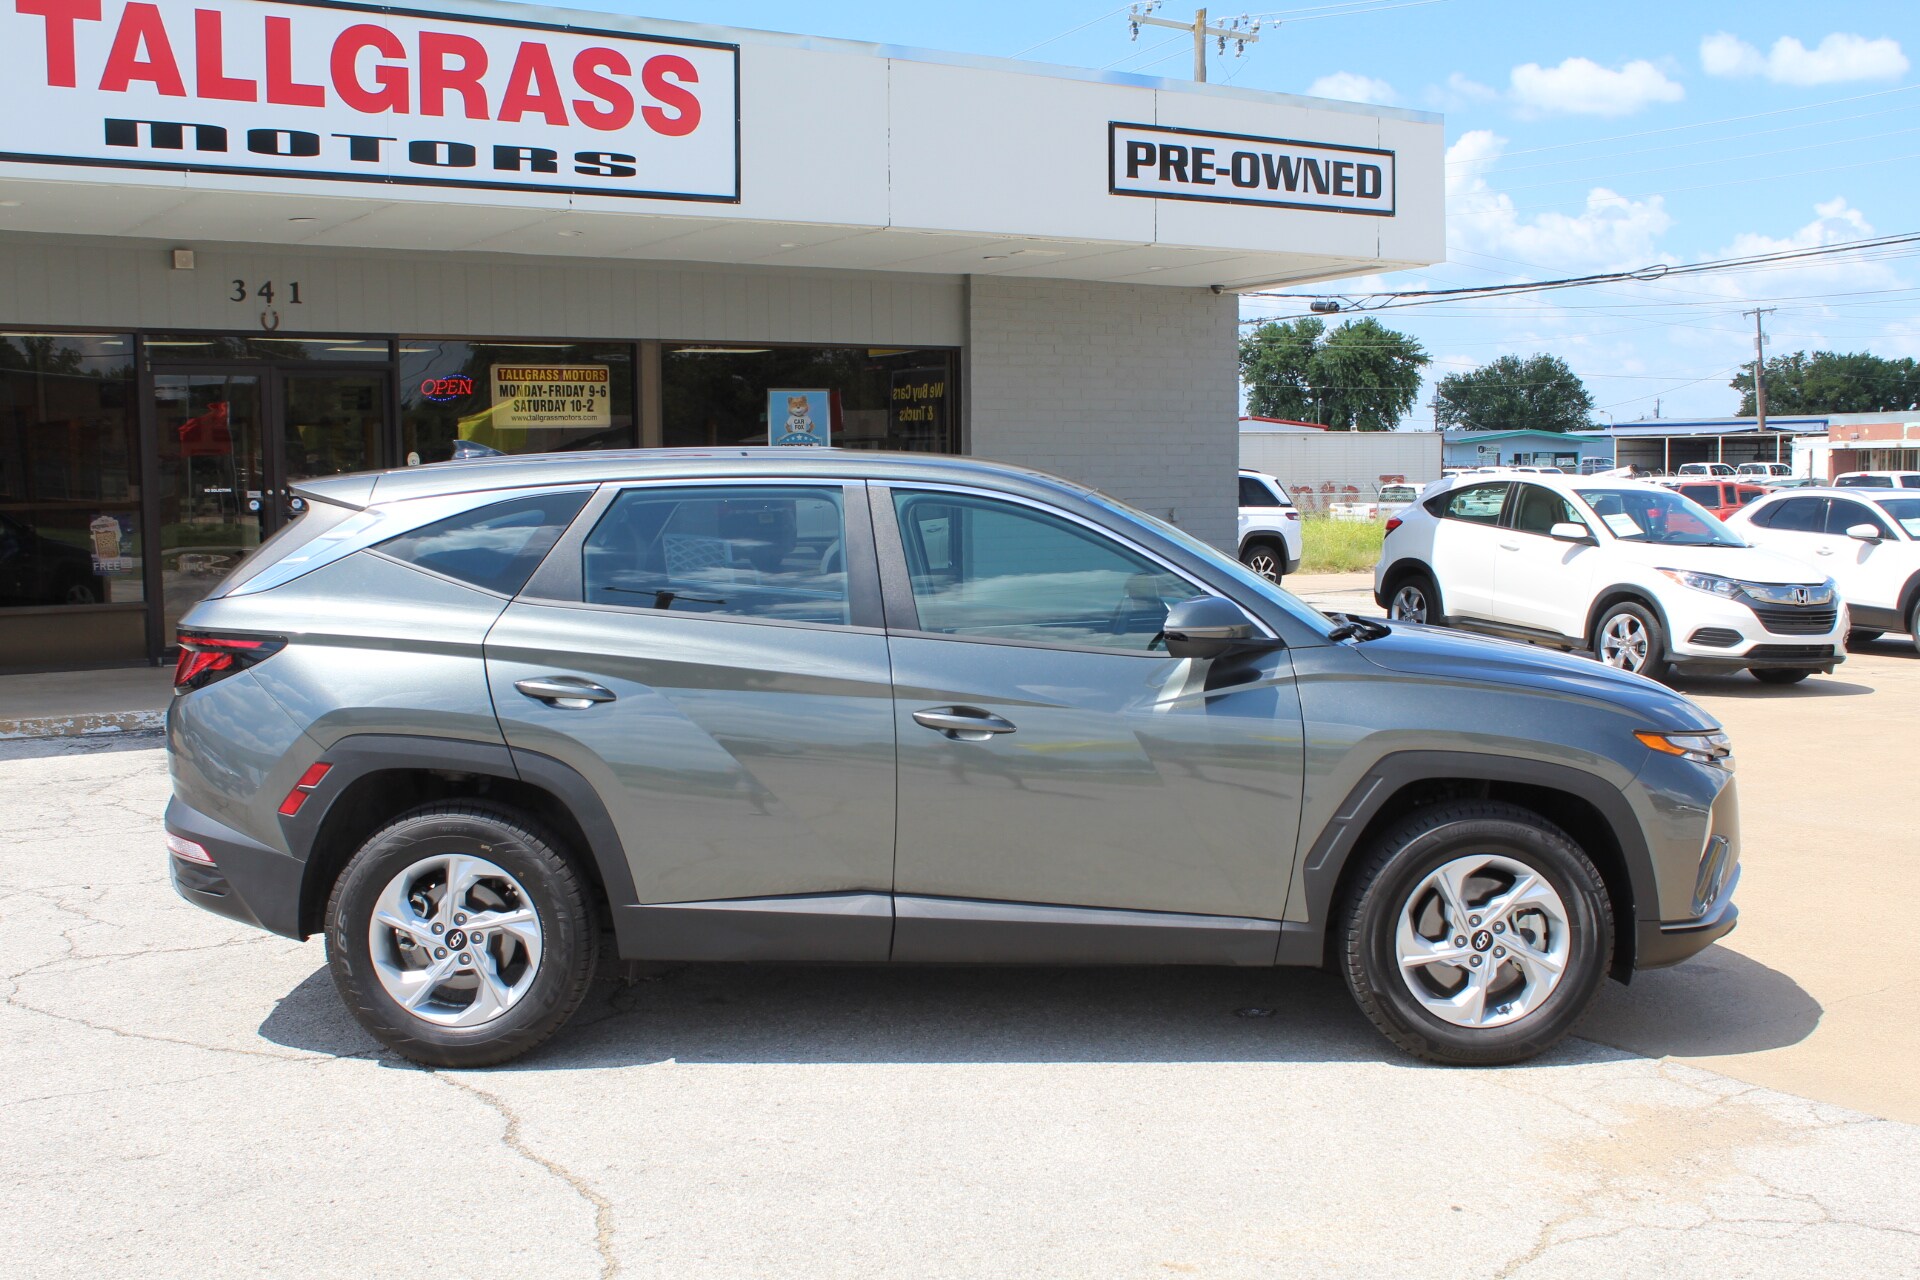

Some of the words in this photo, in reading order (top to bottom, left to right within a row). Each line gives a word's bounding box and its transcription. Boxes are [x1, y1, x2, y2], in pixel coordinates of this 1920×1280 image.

[15, 0, 702, 137] TALLGRASS
[104, 118, 637, 178] MOTORS
[1126, 140, 1382, 199] PRE-OWNED
[230, 279, 302, 304] 341
[500, 369, 559, 380] TALLGRASS
[562, 370, 605, 381] MOTORS
[421, 379, 473, 395] OPEN
[499, 384, 585, 398] MONDAY-FRIDAY
[589, 385, 607, 398] 9-6
[513, 399, 566, 412] SATURDAY
[570, 399, 594, 412] 10-2
[511, 414, 598, 423] www.tallgrassmotors.com
[93, 562, 120, 571] FREE
